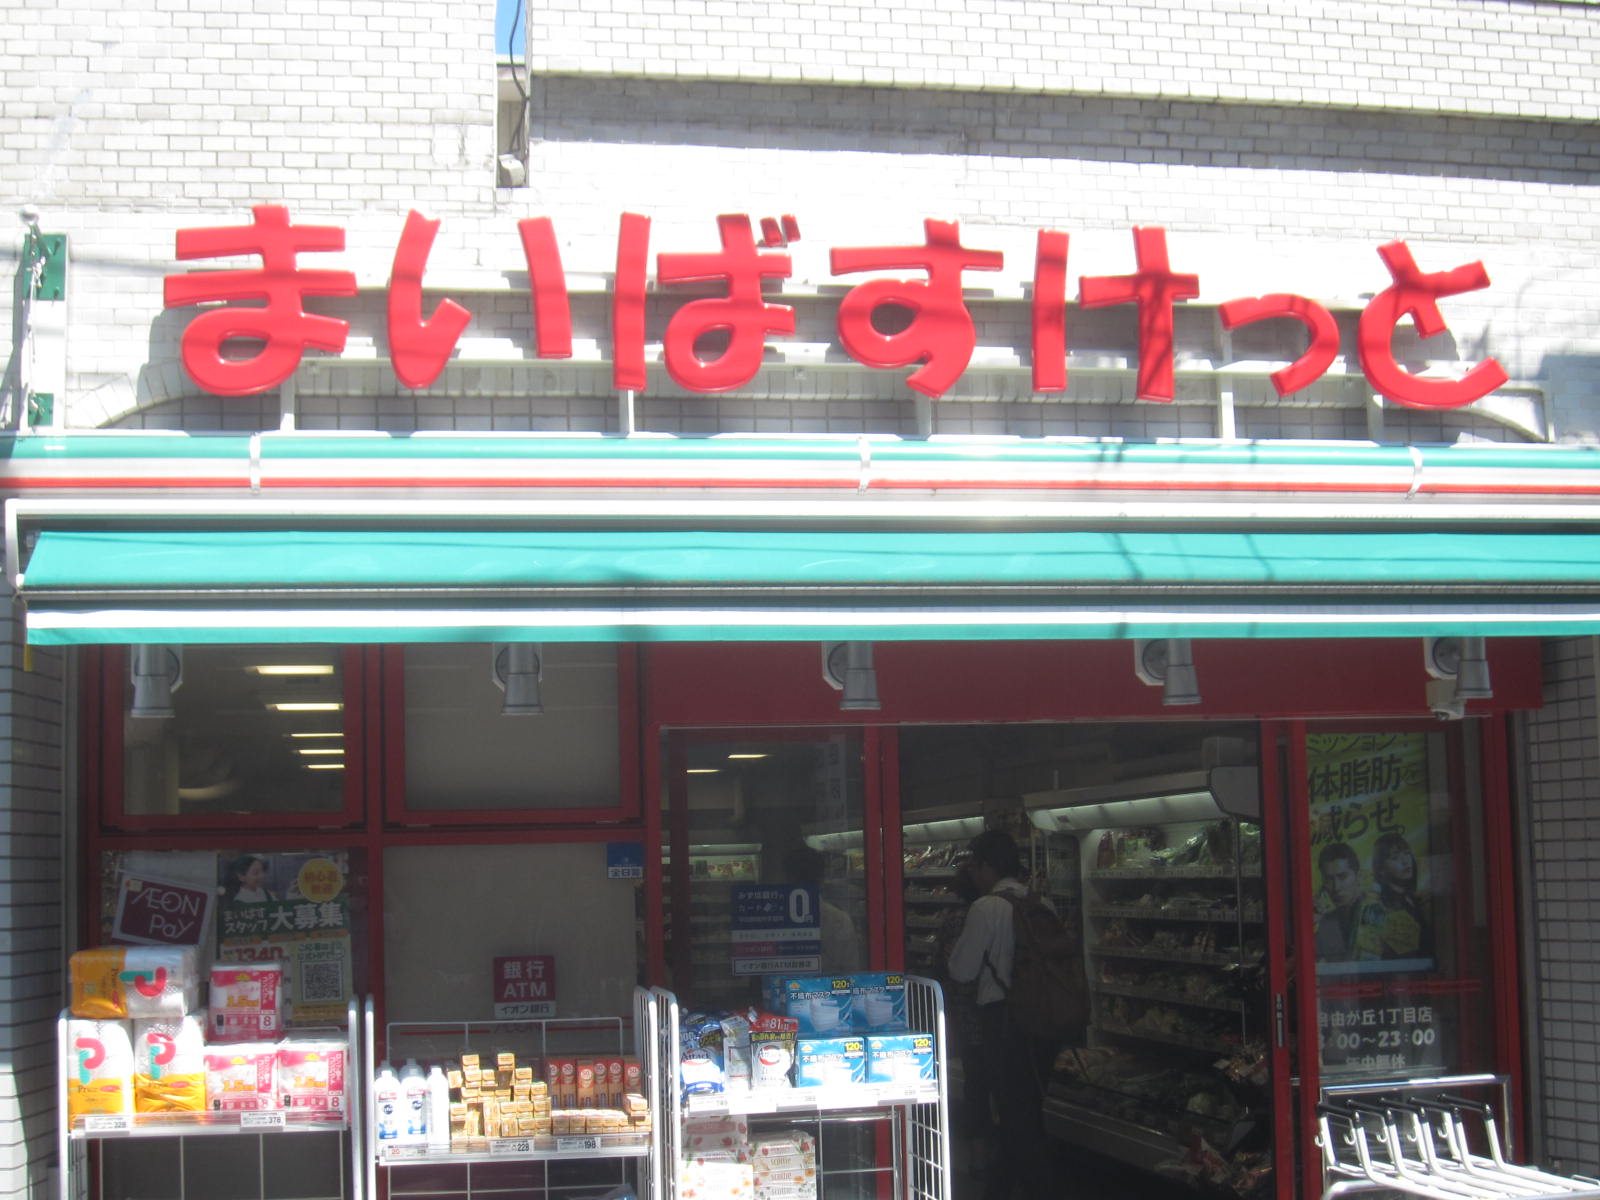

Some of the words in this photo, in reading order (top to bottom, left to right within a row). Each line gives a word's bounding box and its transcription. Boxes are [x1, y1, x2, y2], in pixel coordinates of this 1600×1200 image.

[164, 204, 1509, 411] まいばすけっと
[1308, 753, 1421, 803] 体脂肪を
[149, 912, 195, 939] Pay
[269, 902, 343, 931] 大募集
[503, 960, 545, 979] 銀行
[503, 981, 547, 998] ATM
[501, 1003, 549, 1015] イオン銀行
[1318, 1006, 1433, 1028] 自由が丘1丁目店
[263, 1016, 272, 1026] 8
[331, 1097, 340, 1107] 8
[517, 1143, 530, 1152] 228
[584, 1140, 597, 1149] 198
